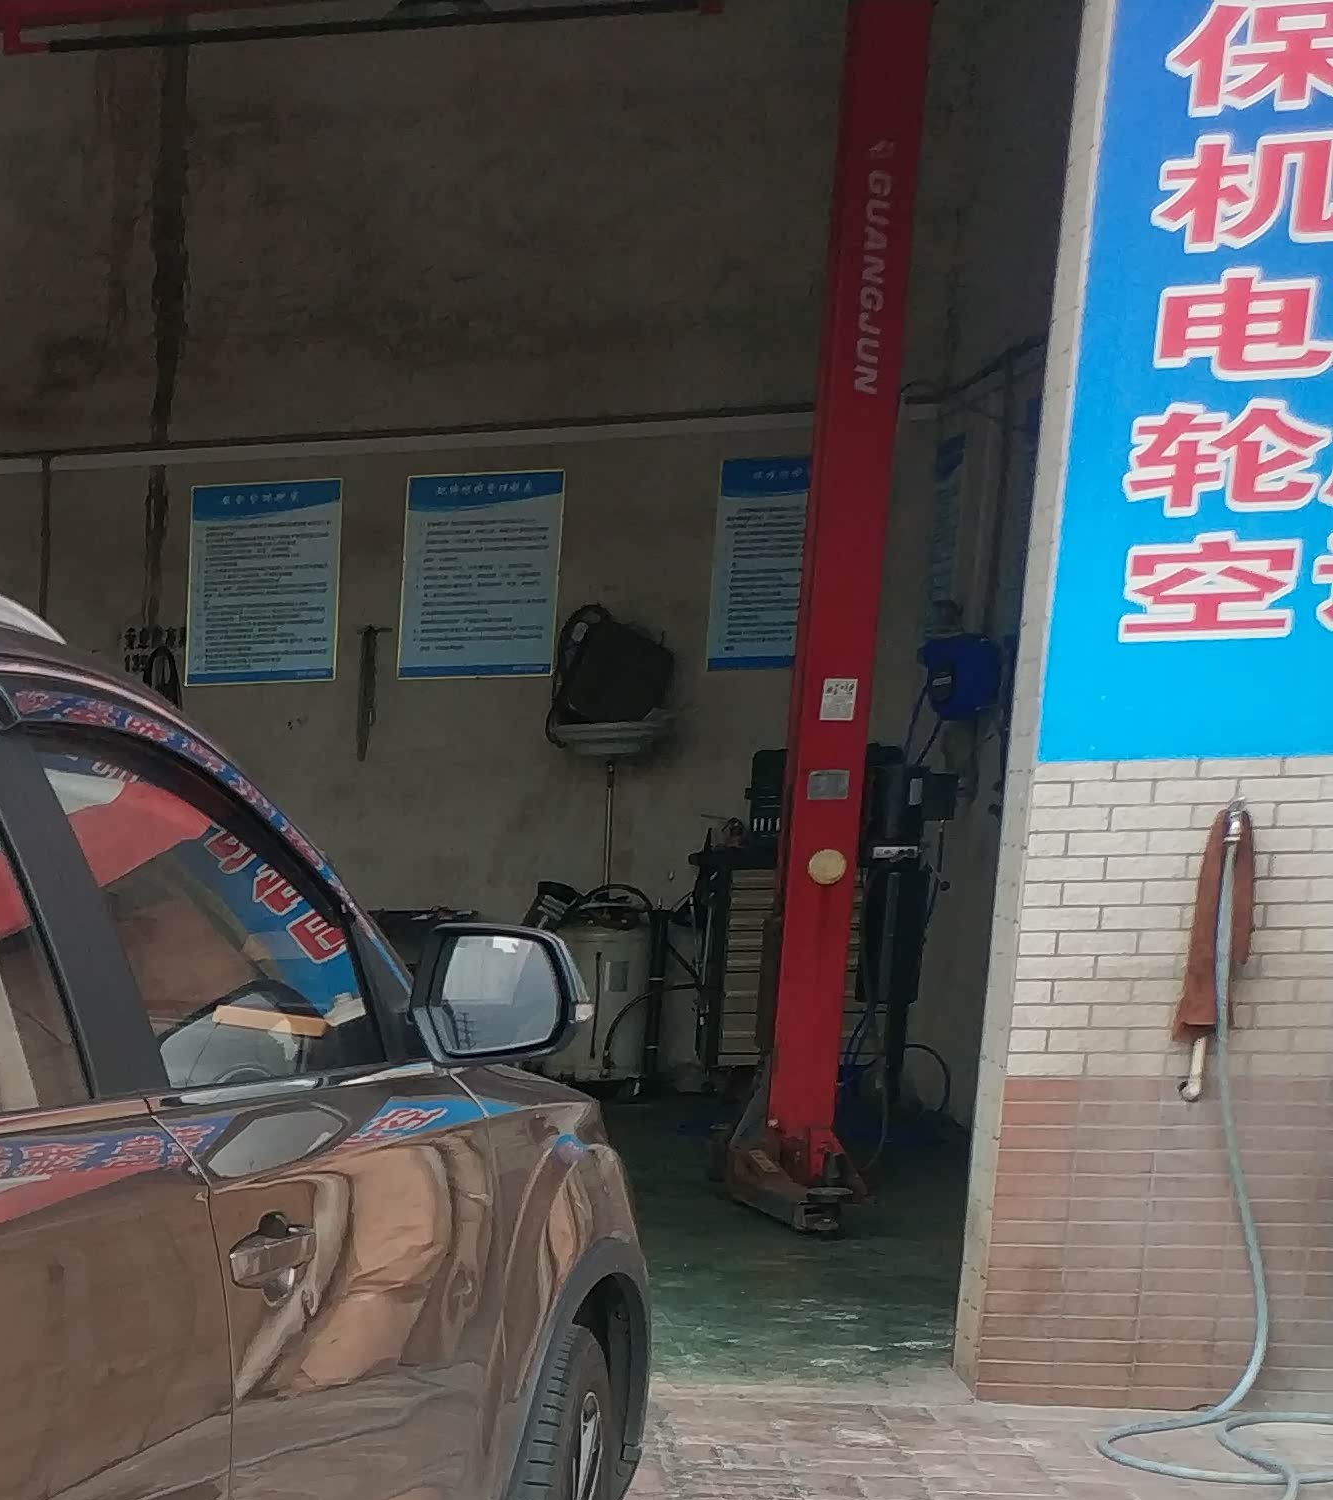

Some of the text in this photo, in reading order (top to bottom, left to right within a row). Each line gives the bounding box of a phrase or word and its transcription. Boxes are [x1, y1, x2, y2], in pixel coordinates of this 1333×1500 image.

[1165, 0, 1333, 117] 保
[1150, 133, 1333, 254] 机
[854, 169, 892, 394] GUANGJUN
[1152, 266, 1333, 381] 电
